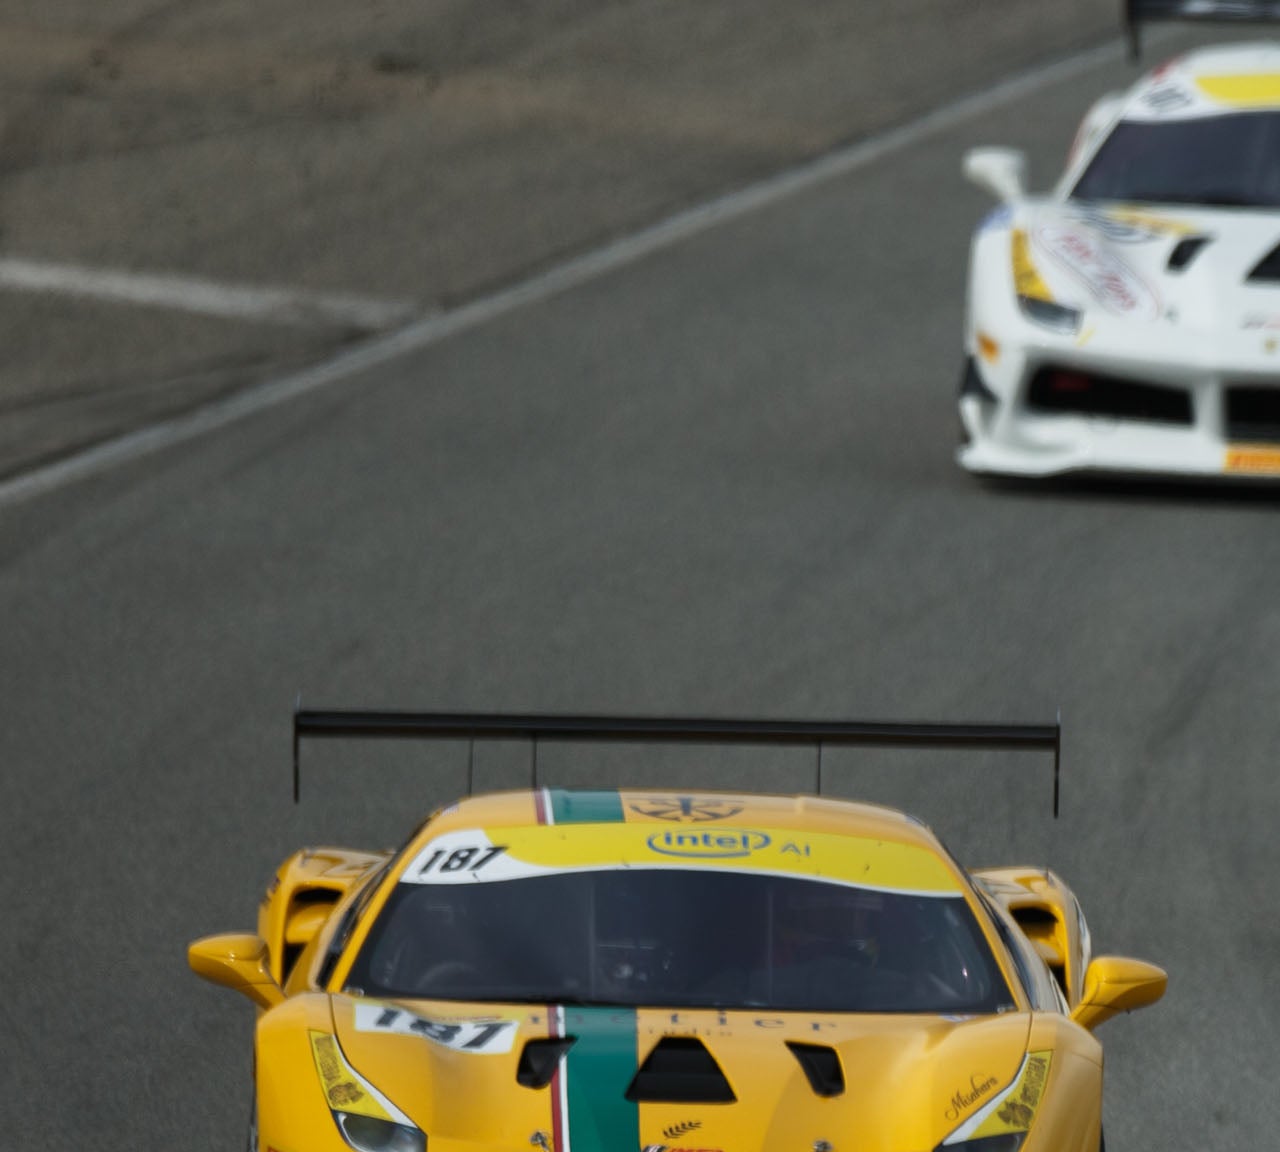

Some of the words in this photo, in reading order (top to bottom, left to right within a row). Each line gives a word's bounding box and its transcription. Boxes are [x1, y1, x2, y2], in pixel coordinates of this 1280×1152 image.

[418, 845, 510, 875] 187
[781, 842, 811, 857] AI
[375, 1008, 513, 1049] 187
